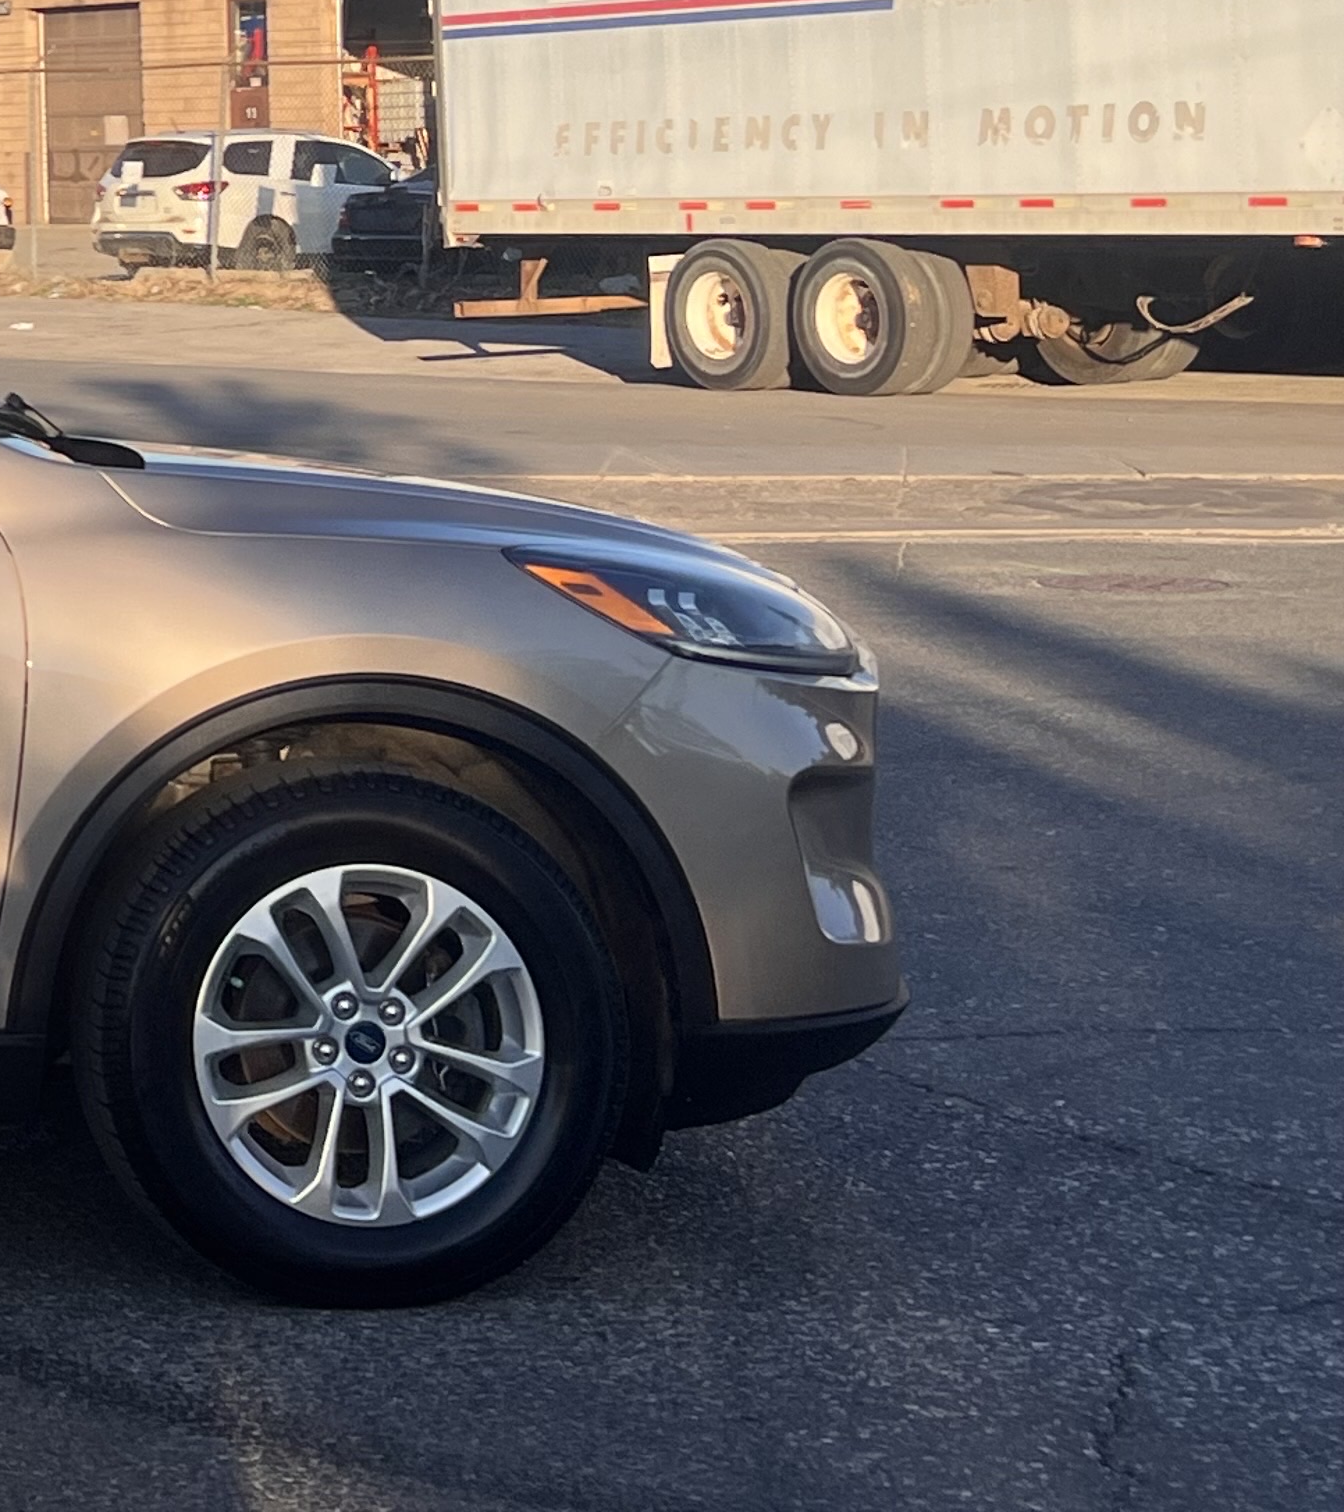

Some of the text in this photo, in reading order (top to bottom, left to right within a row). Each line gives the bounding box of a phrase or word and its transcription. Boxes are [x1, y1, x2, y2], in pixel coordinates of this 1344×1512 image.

[553, 100, 1207, 157] EFFICIENCY IN MOTION
